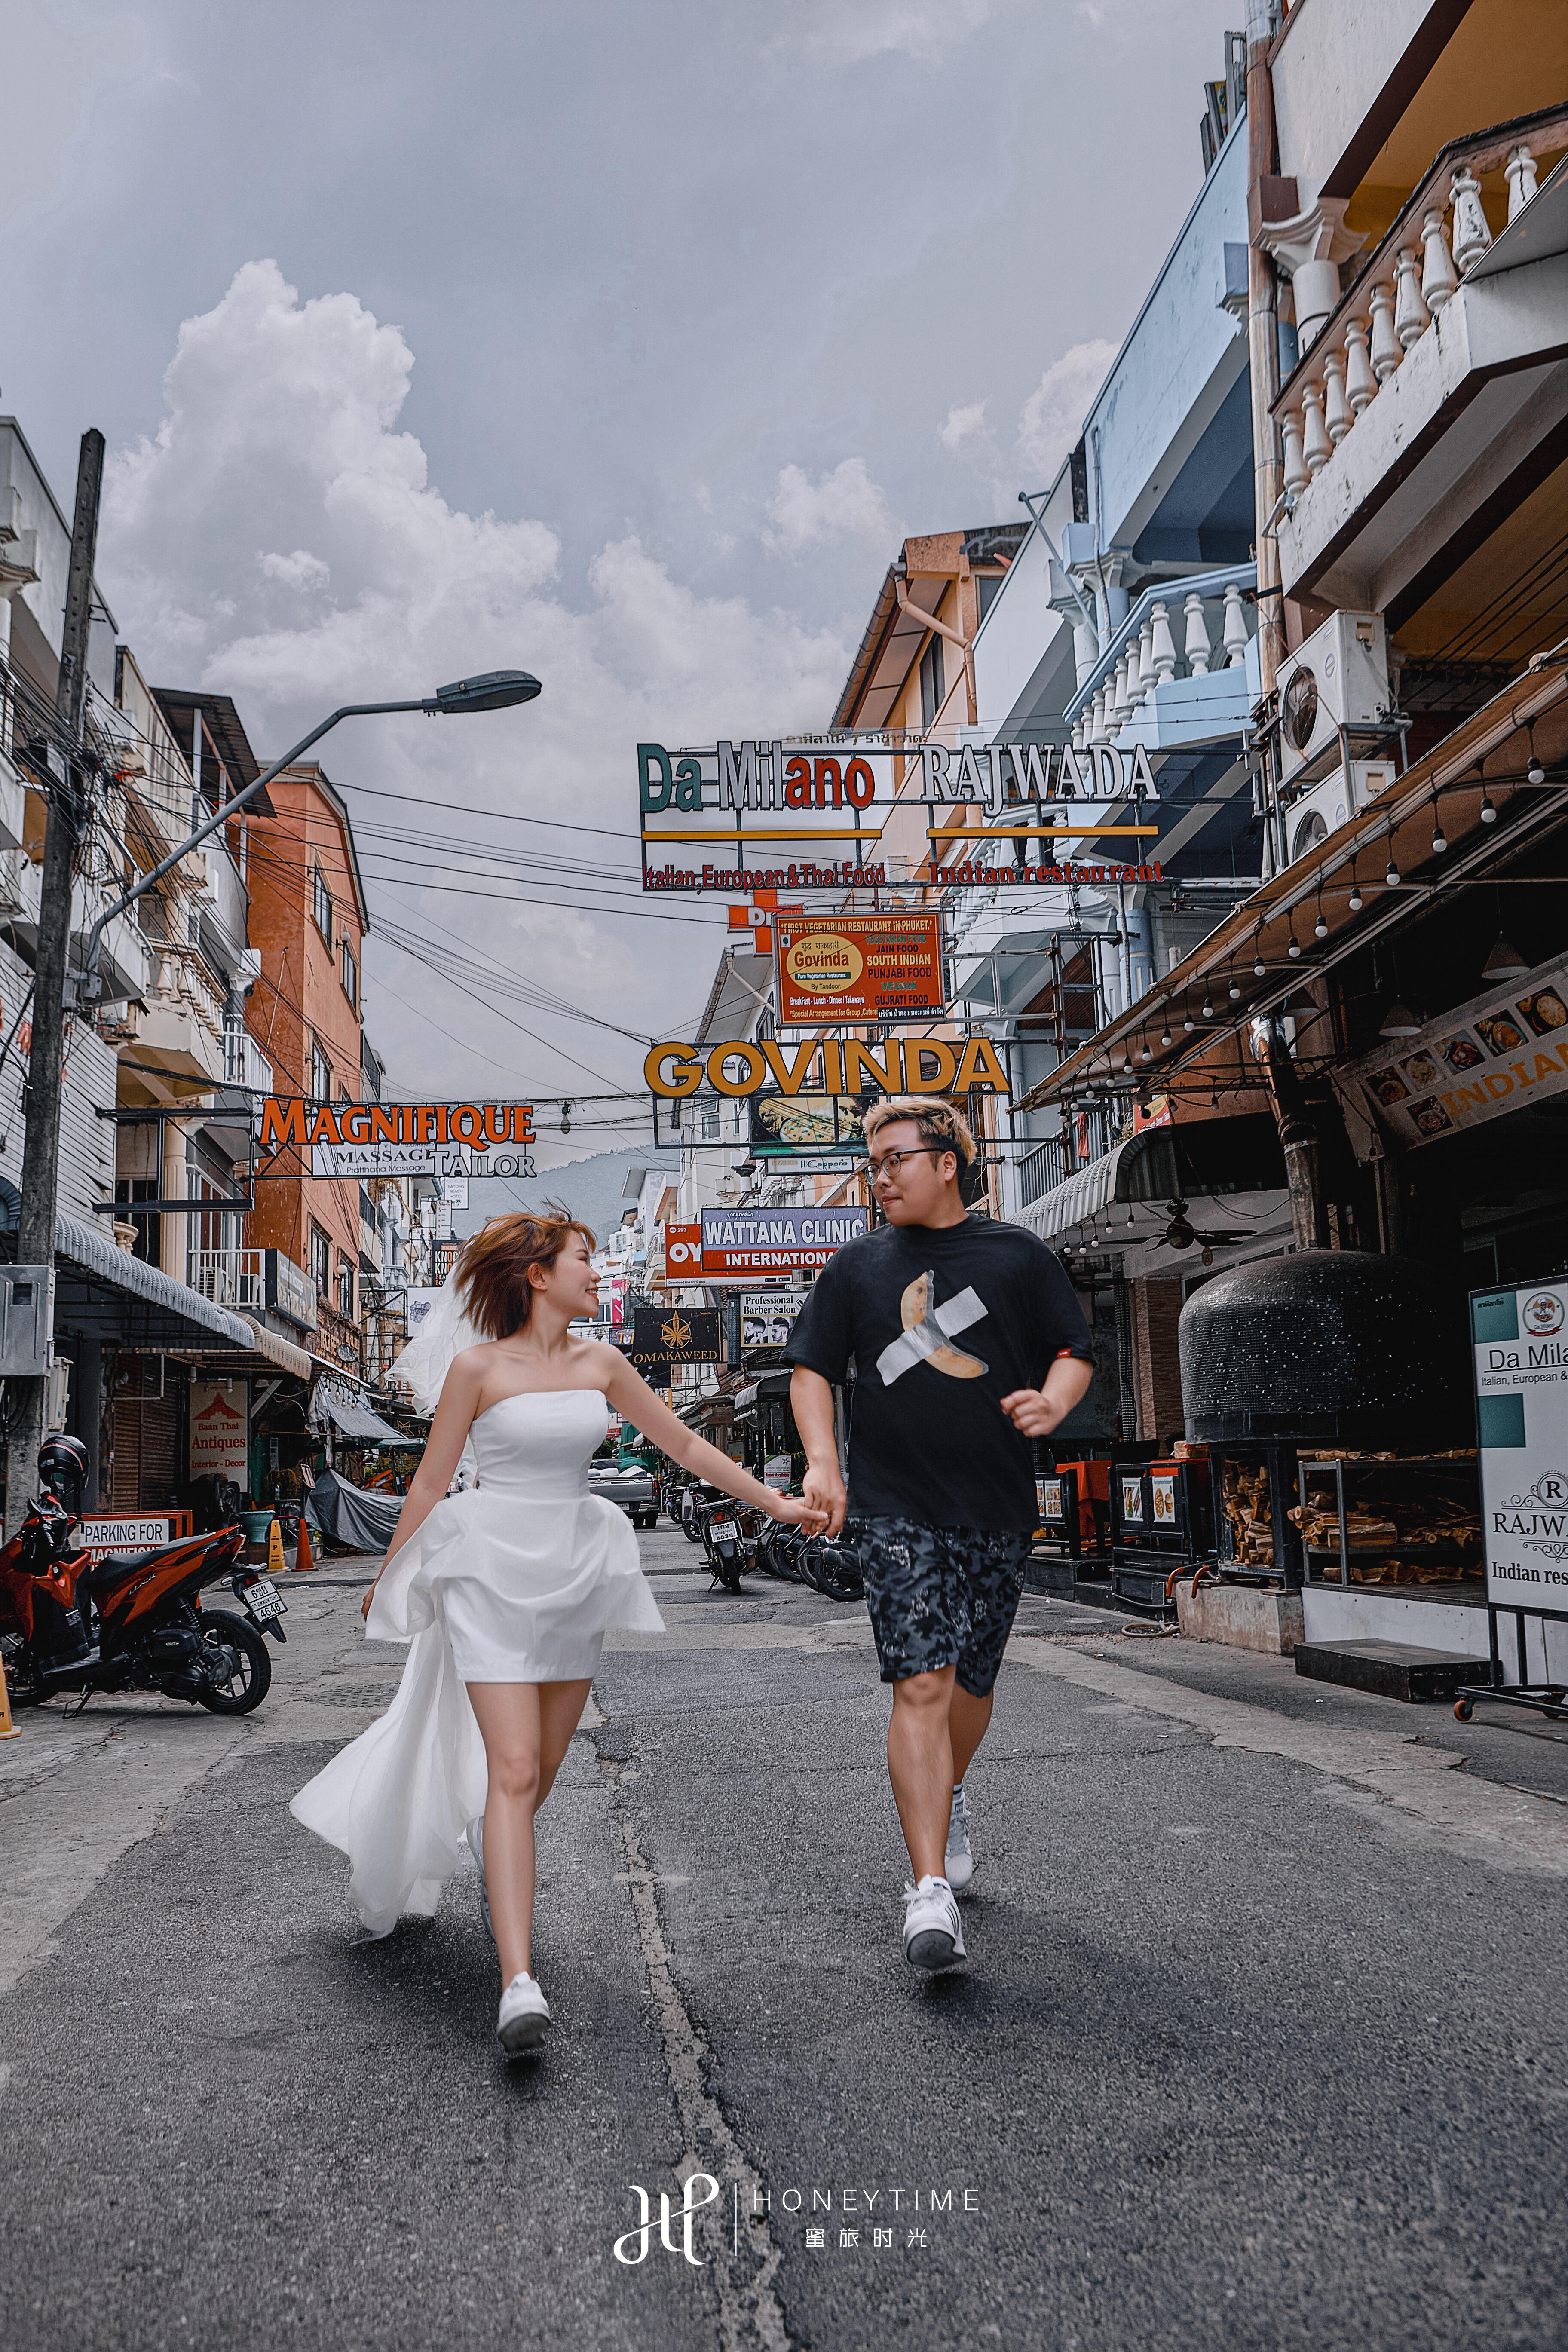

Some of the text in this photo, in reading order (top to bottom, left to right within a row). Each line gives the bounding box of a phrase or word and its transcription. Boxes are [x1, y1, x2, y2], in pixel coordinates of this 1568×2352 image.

[637, 741, 874, 812] Da Milano
[919, 743, 1161, 818] RAJWADA
[842, 862, 885, 886] Food
[928, 861, 1164, 884] Indian restaurant
[805, 921, 847, 933] VEGETARIAN
[848, 921, 891, 932] RESTAURANT
[893, 920, 900, 931] IN
[865, 934, 926, 945] VEGETARIAN FOOD
[897, 944, 919, 952] FOOD
[794, 950, 849, 967] Govinda
[867, 954, 931, 966] SOUTH INDIAN
[868, 967, 931, 979] PUNJABI FOOD
[881, 981, 916, 991] VEGAN
[790, 996, 810, 1005] BreakFast
[813, 996, 826, 1004] Lunch
[829, 995, 842, 1004] Dinner
[875, 994, 928, 1005] GUJRATI FOOD
[809, 1009, 838, 1018] Arrangement
[846, 1008, 860, 1017] Group
[878, 1008, 893, 1017] บริษัท
[931, 1007, 943, 1015] จำกัด
[644, 1037, 1011, 1097] GOVINDA
[260, 1099, 537, 1152] MAGNIFIQUE
[430, 1151, 537, 1178] TAILOR
[807, 1158, 848, 1169] Cappero
[705, 1219, 864, 1245] WATTANA CLINIC
[746, 1295, 793, 1305] Professional
[744, 1305, 796, 1314] Barber Salon
[634, 1351, 717, 1364] OMAKAWEED
[1489, 1350, 1519, 1369] Da
[1482, 1376, 1510, 1386] Italian,
[1513, 1372, 1558, 1384] European
[192, 1436, 245, 1452] Antiques
[191, 1460, 218, 1468] Interior
[1546, 1481, 1563, 1498] R
[1492, 1513, 1568, 1537] RAJW
[85, 1524, 162, 1543] PARKING FOR
[1492, 1561, 1541, 1582] Indian
[261, 1603, 281, 1617] 4646
